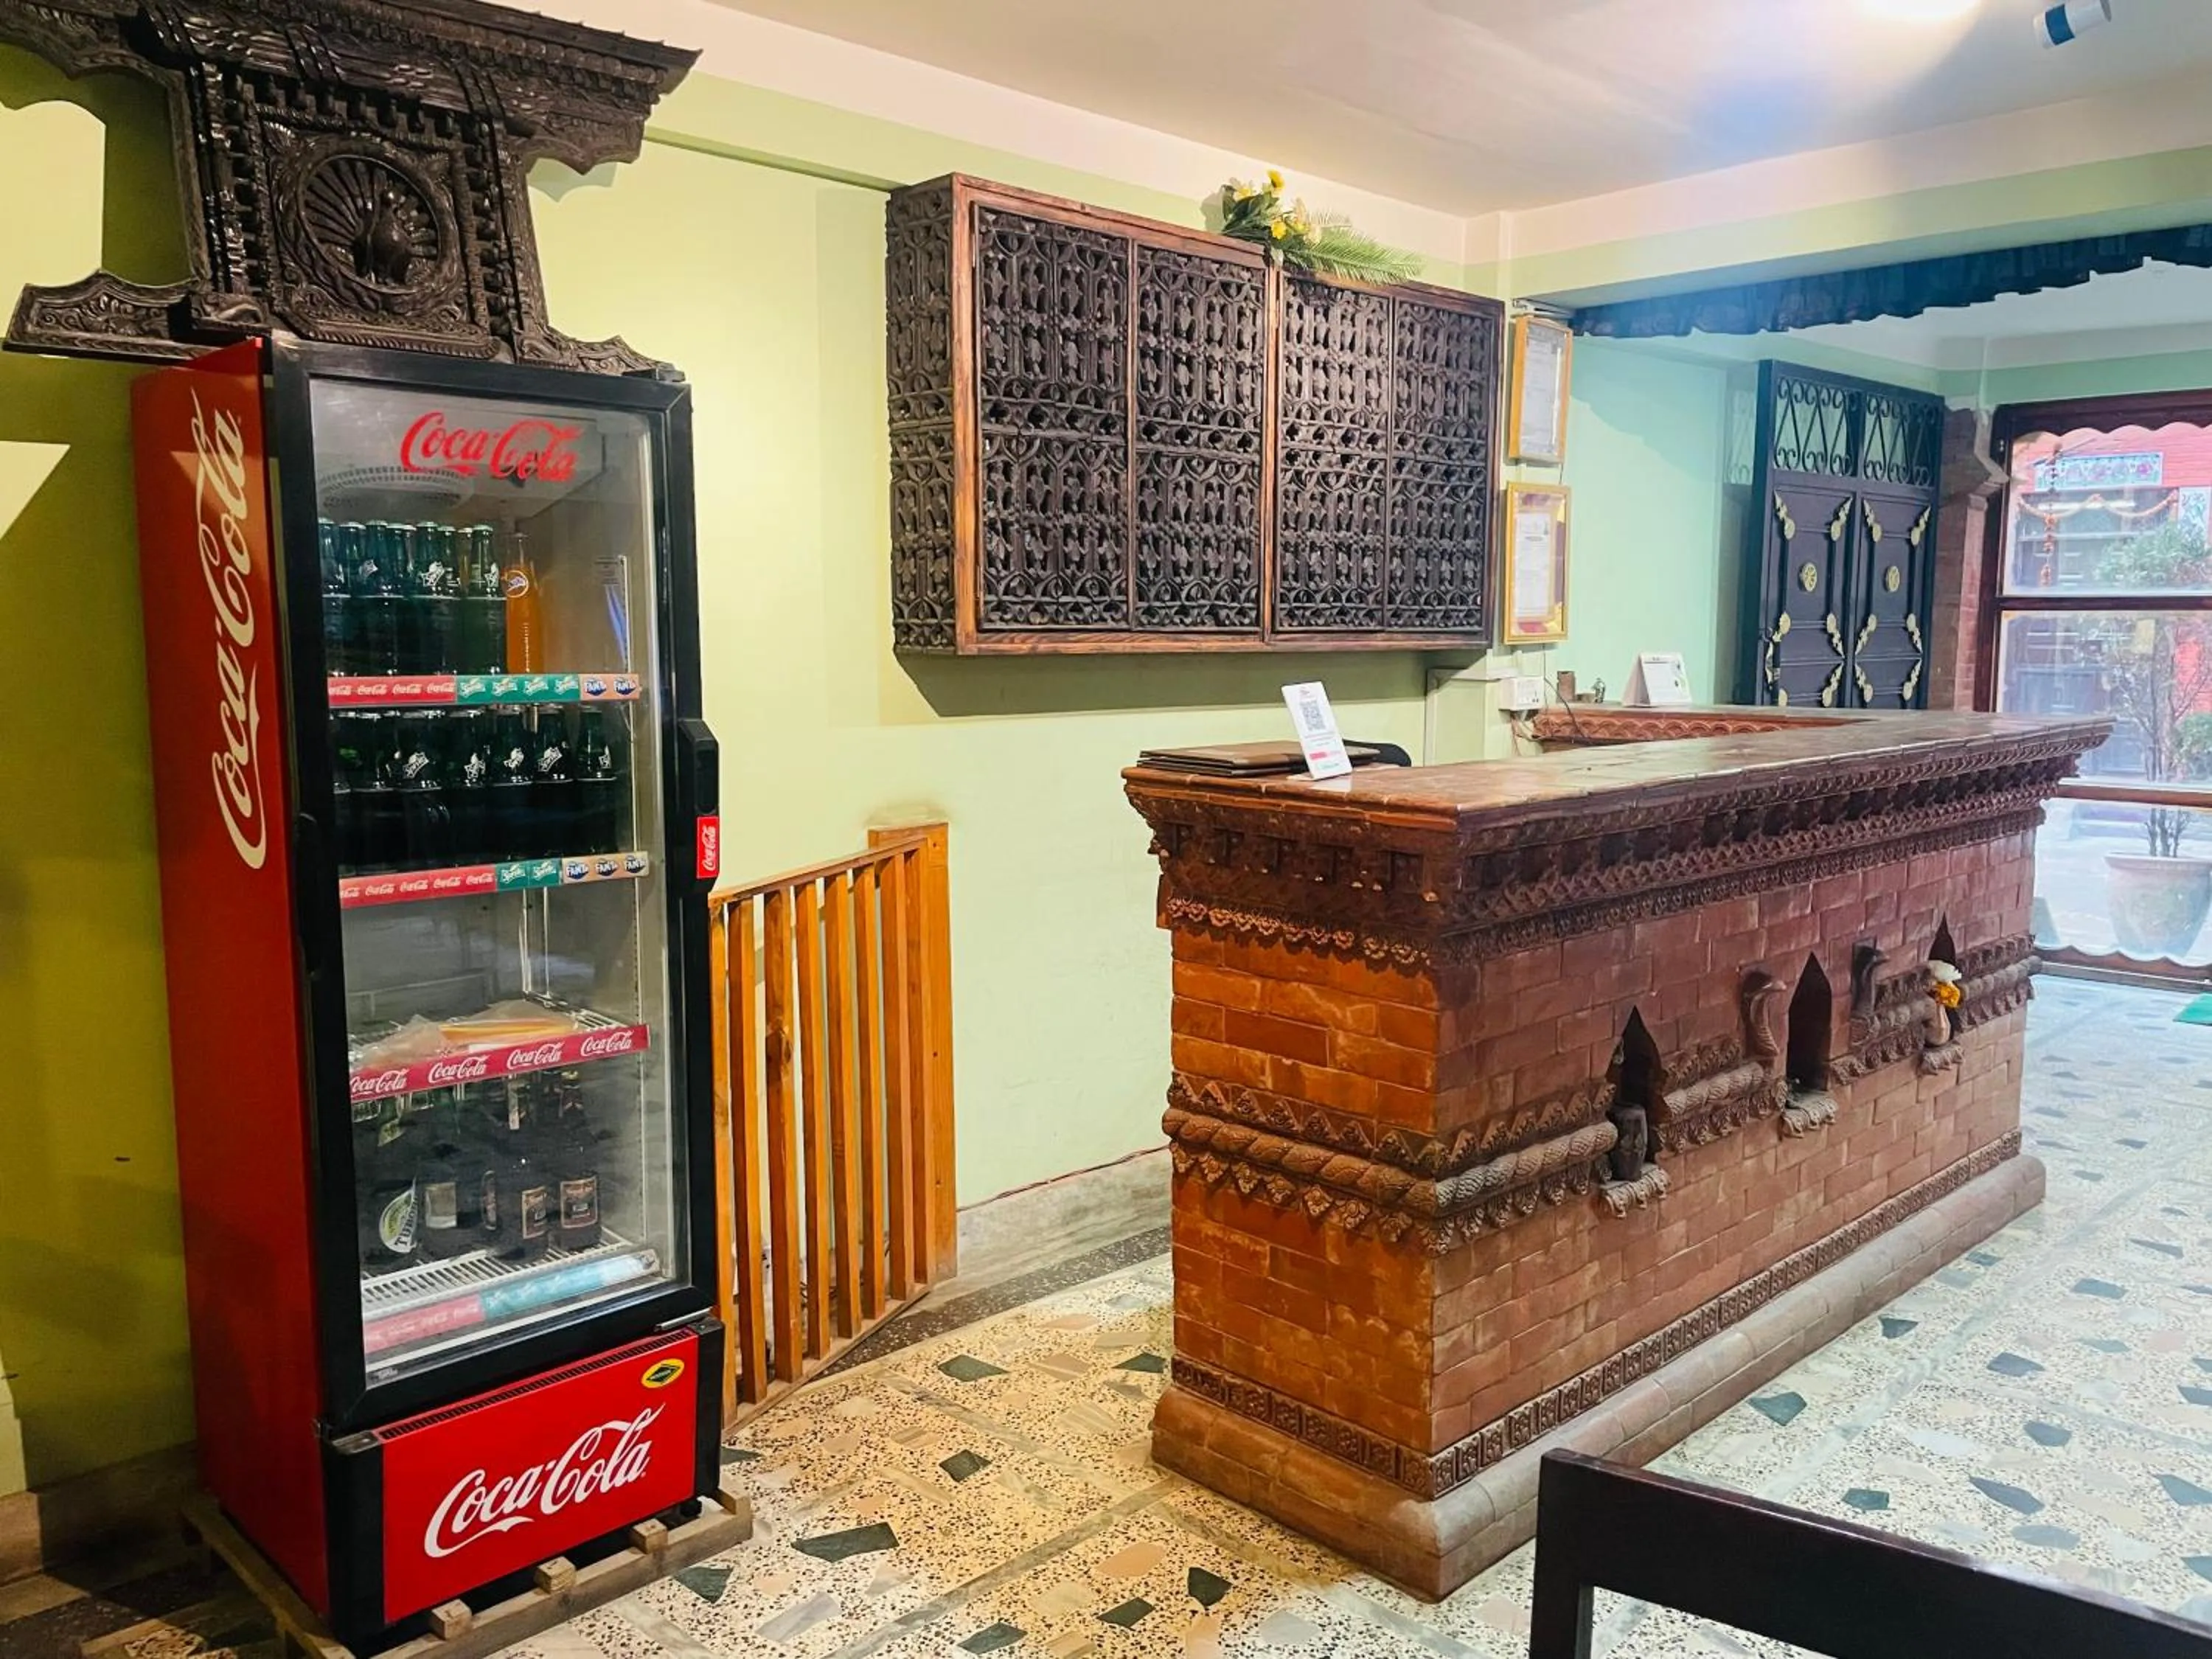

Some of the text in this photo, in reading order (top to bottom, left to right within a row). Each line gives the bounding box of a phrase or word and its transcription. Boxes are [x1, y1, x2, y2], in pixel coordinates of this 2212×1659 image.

[400, 410, 582, 483] Coca-Cola
[191, 386, 266, 869] Coca-Cola
[428, 1055, 489, 1083] Coca-Cola
[507, 1042, 566, 1069] Coca-Cola
[580, 1031, 634, 1057] Coca-Cola
[424, 1403, 666, 1558] Coca-Cola
